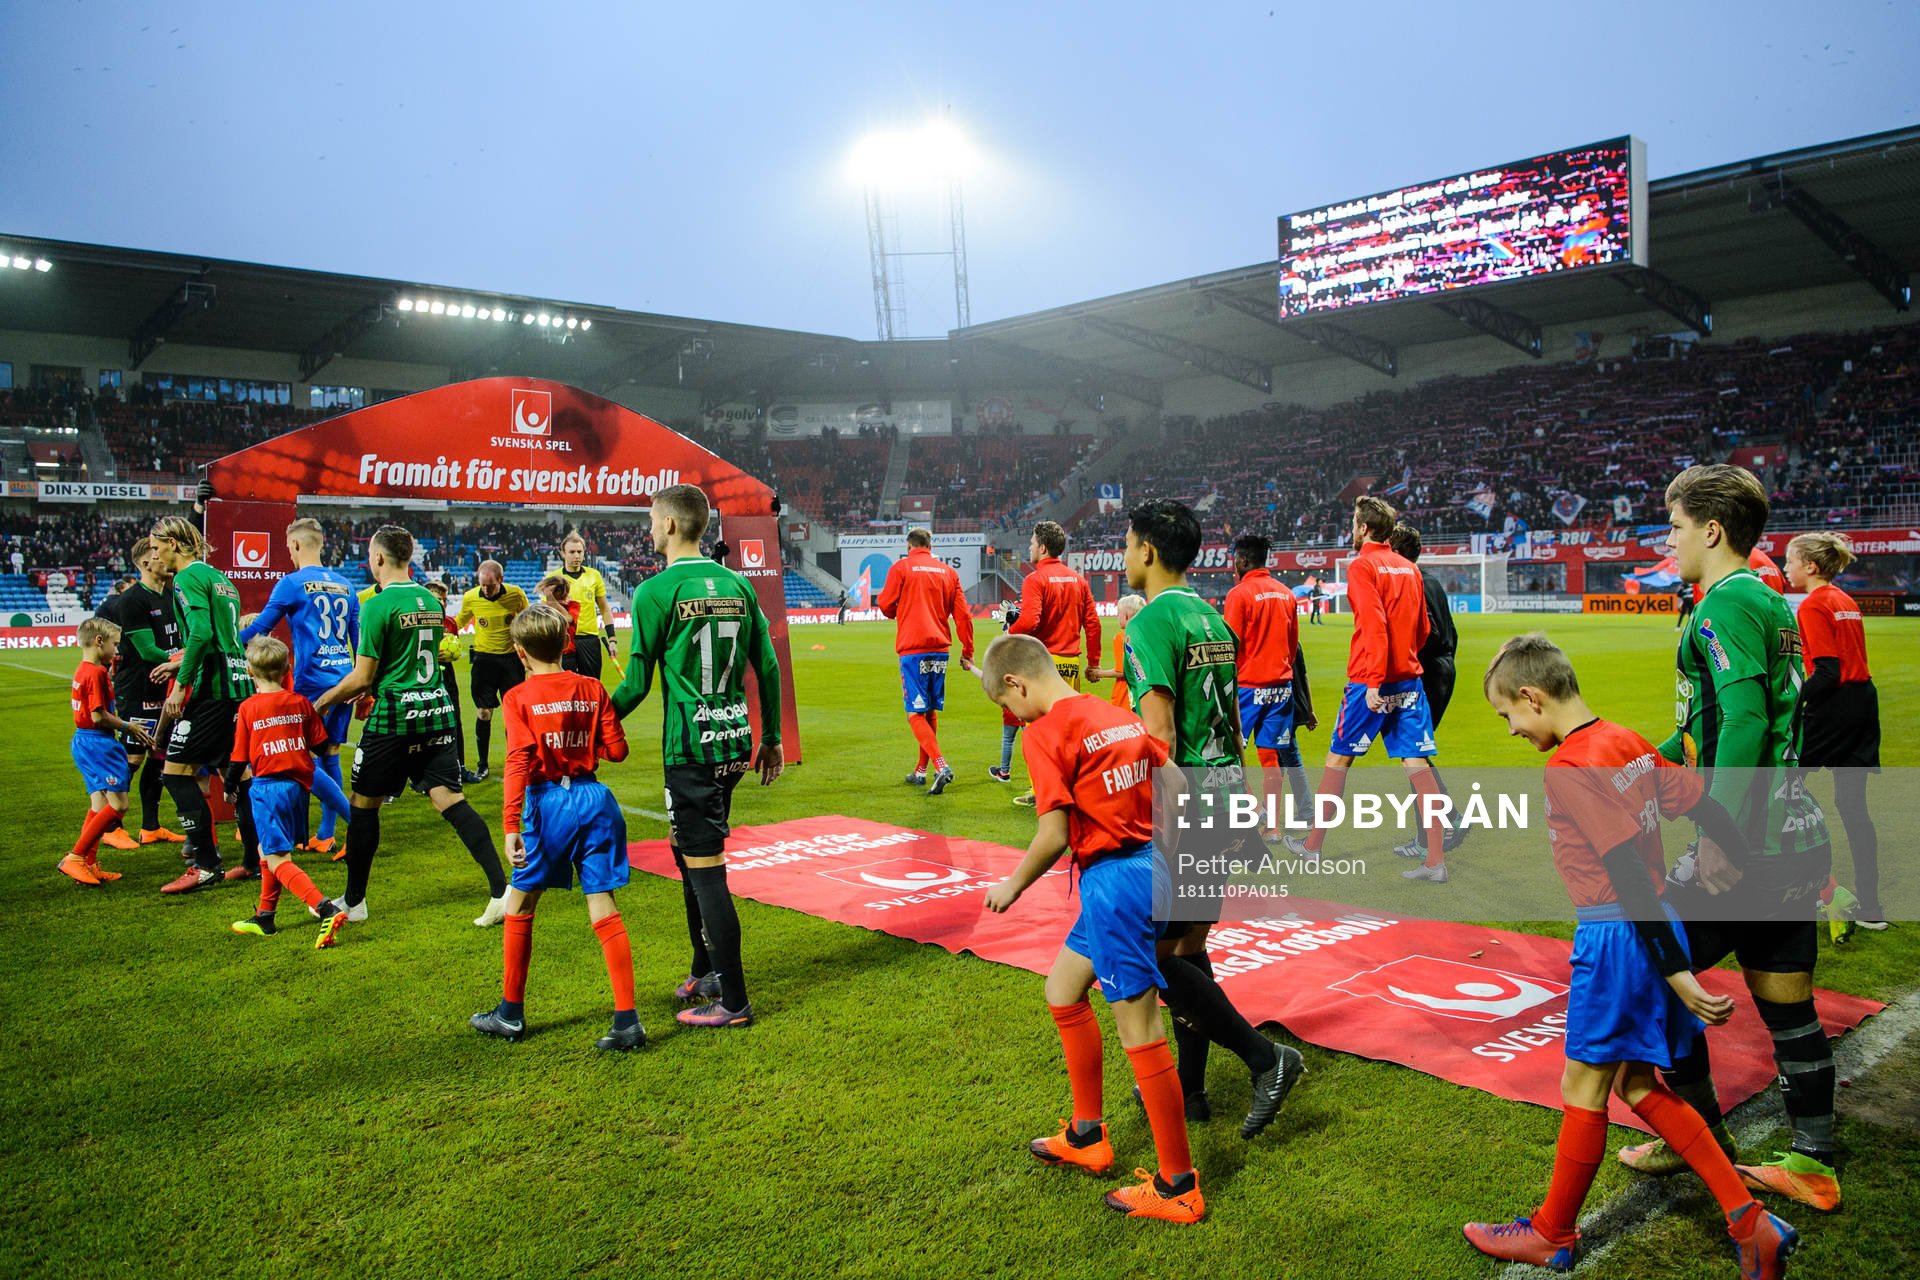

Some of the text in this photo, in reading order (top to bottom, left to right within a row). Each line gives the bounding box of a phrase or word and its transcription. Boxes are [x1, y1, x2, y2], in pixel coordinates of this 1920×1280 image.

[490, 436, 572, 452] SVENSKA SPEL
[358, 454, 461, 488] Framåt
[466, 460, 507, 490] för
[509, 464, 592, 494] svensk
[44, 484, 147, 497] DIN-X DIESEL
[840, 536, 907, 544] KLIPPANS BUS
[1560, 532, 1591, 546] RBU
[681, 602, 704, 618] XL
[1590, 596, 1673, 614] min cykel
[35, 613, 65, 624] Solid
[314, 595, 349, 640] 33
[320, 658, 352, 668] Derom
[416, 629, 434, 684] 5
[692, 621, 741, 696] 17
[1188, 646, 1210, 666] XL
[262, 738, 288, 756] FAIR
[1102, 764, 1134, 795] FAIR
[1472, 1009, 1568, 1062] SVENS
